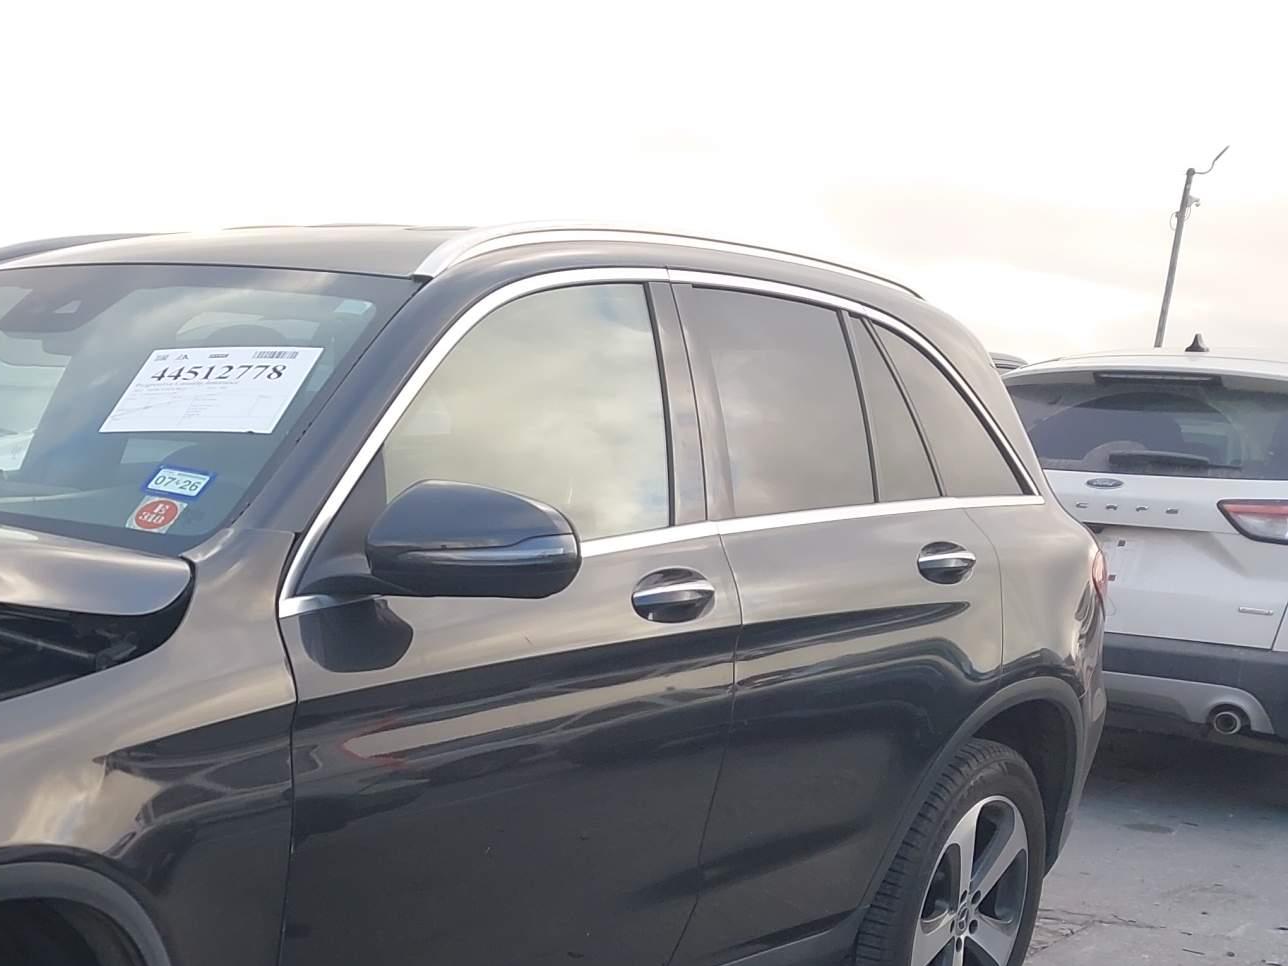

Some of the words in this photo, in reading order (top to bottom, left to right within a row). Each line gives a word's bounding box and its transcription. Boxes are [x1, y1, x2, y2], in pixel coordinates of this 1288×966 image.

[151, 364, 287, 382] 44512778
[153, 475, 177, 488] 07
[178, 479, 202, 492] 26
